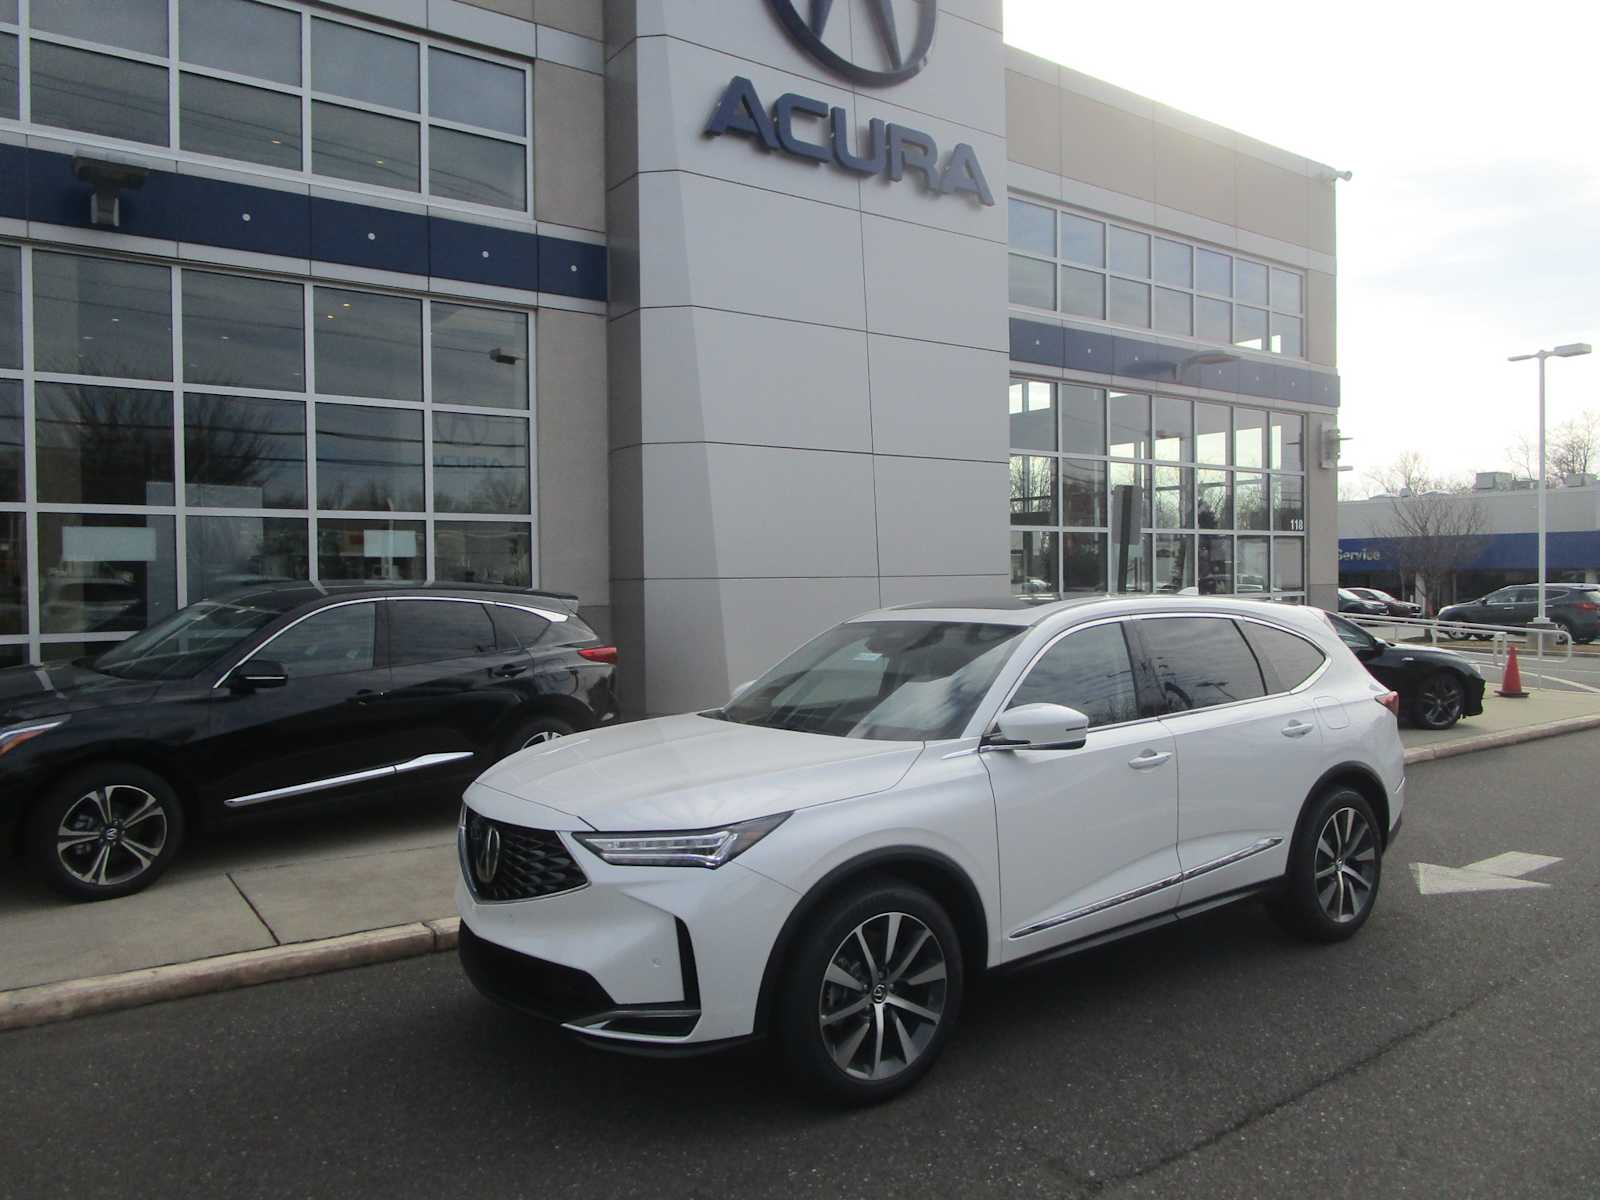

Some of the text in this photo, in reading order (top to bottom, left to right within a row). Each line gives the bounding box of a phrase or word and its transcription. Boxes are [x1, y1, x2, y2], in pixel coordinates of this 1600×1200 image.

[704, 75, 995, 206] ACURA
[1290, 519, 1304, 531] 118
[1337, 548, 1380, 561] Service
